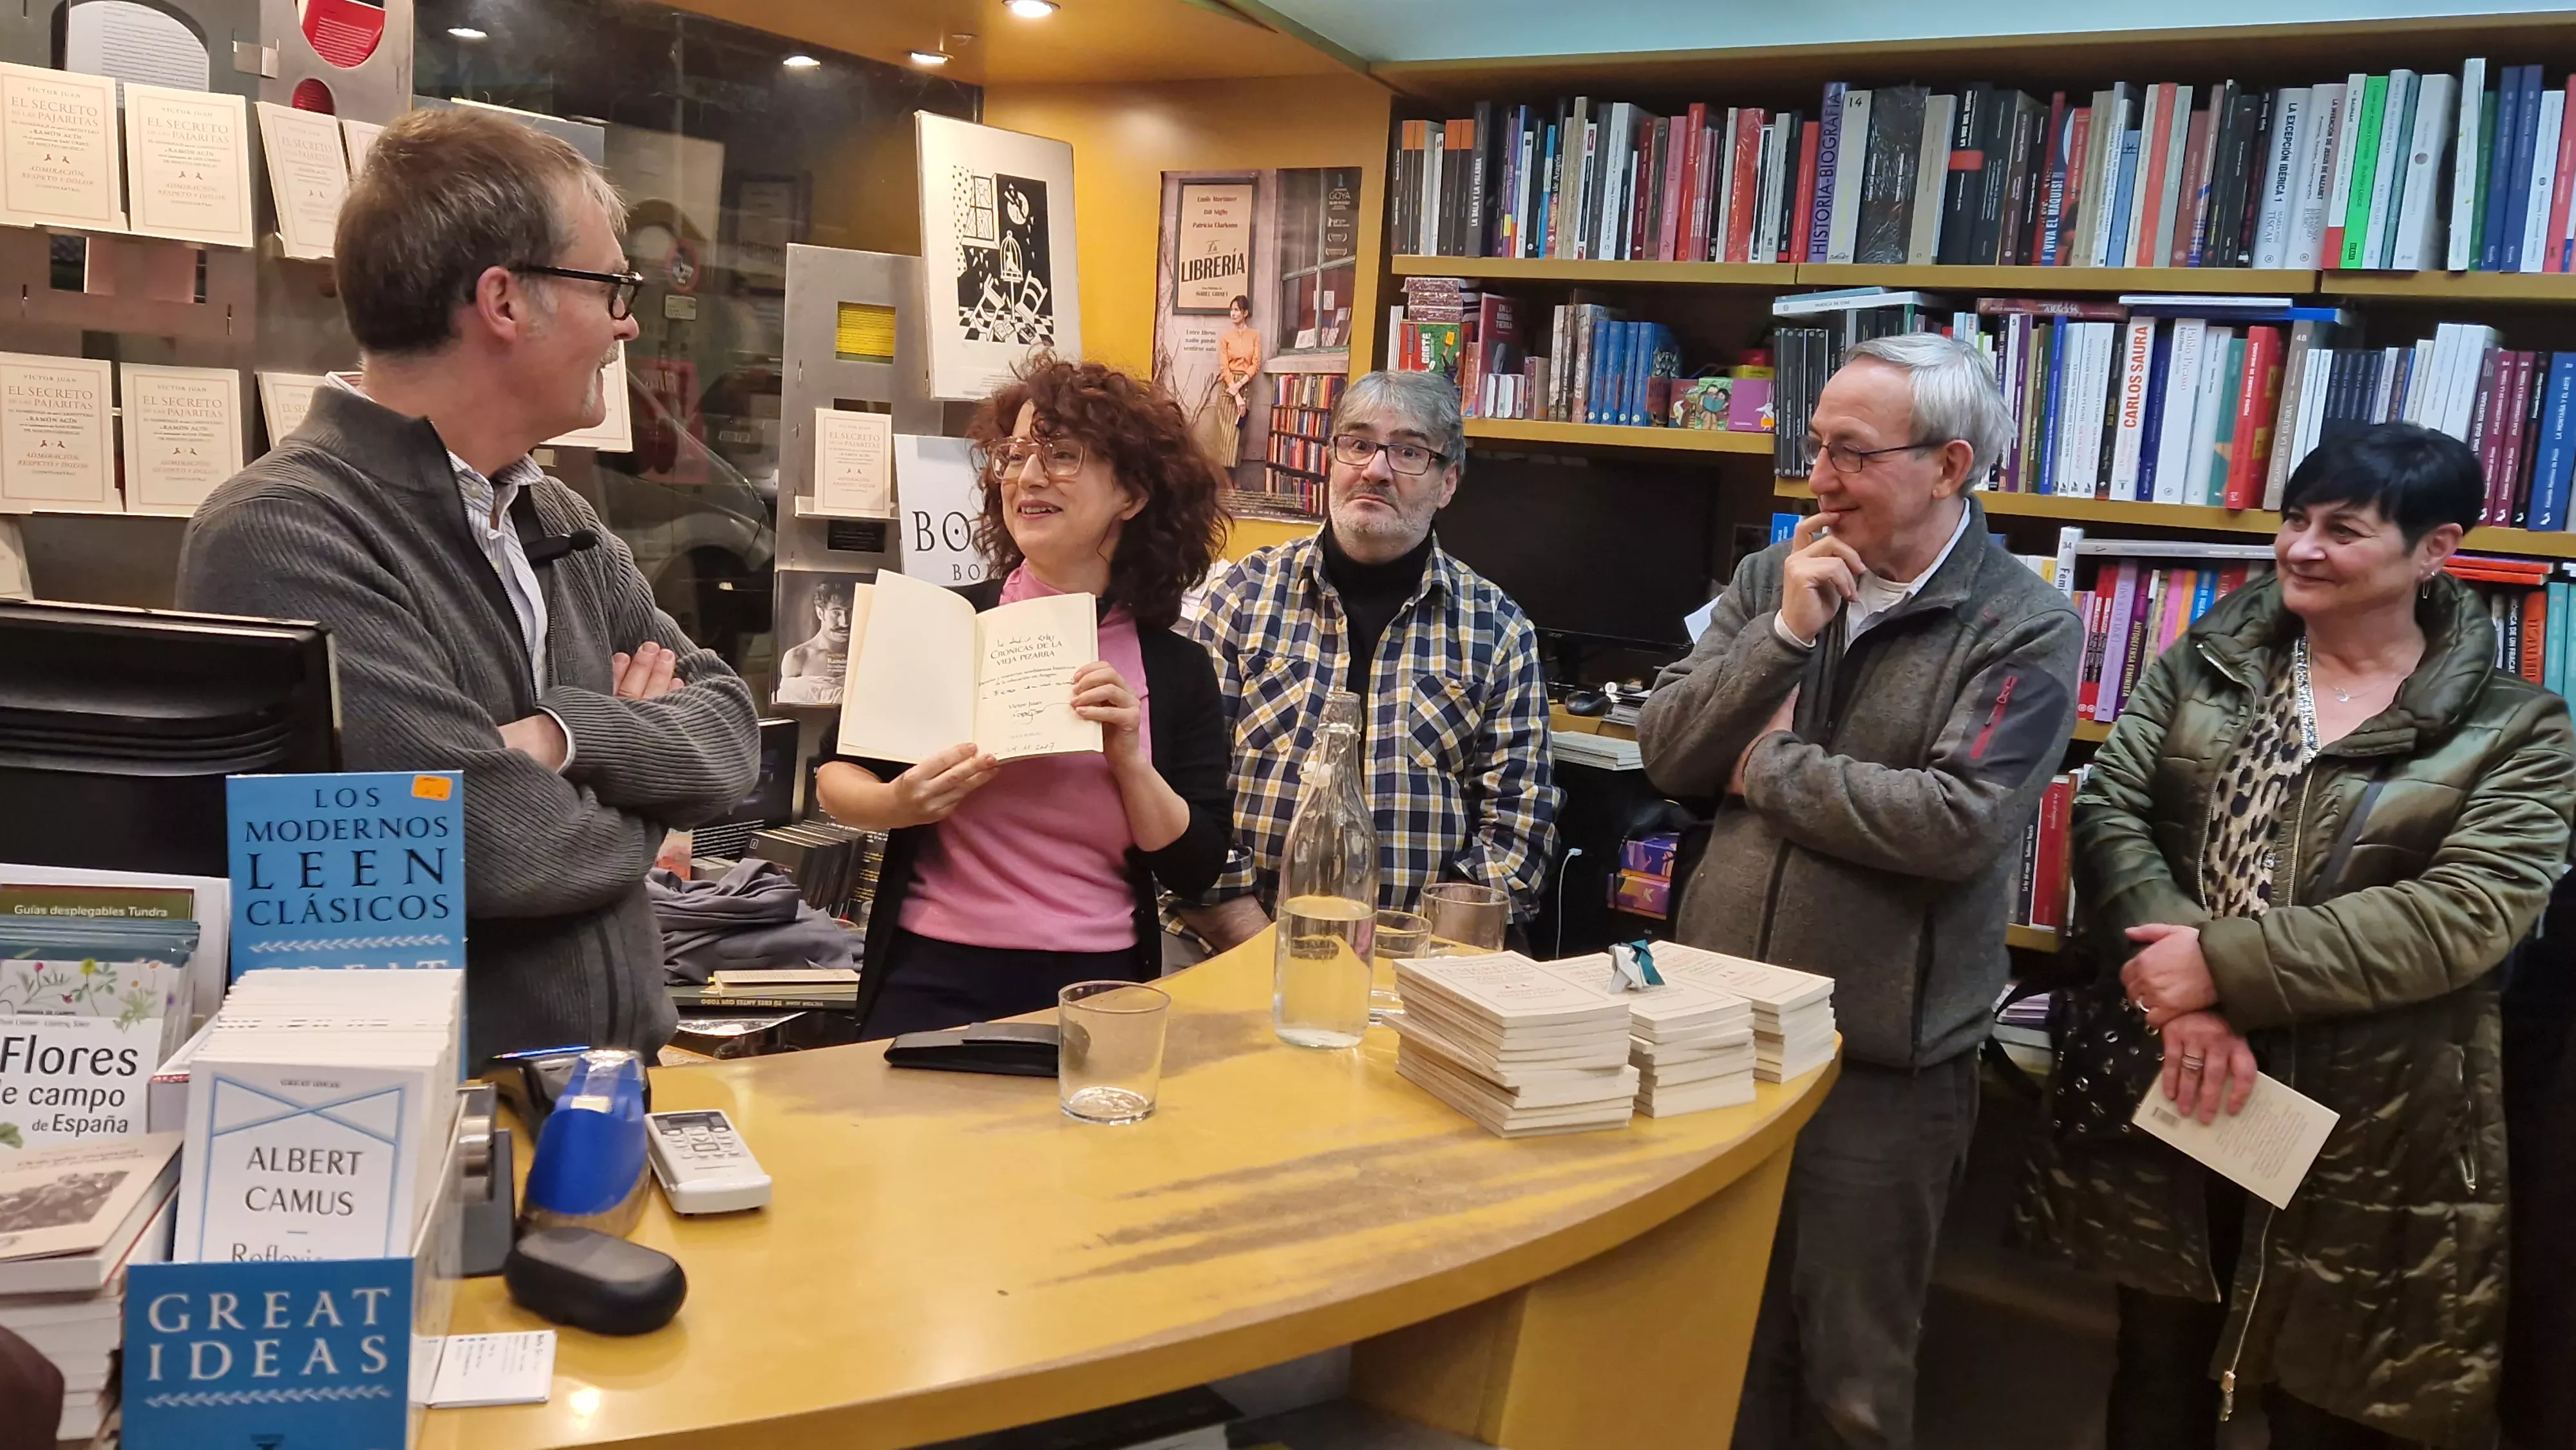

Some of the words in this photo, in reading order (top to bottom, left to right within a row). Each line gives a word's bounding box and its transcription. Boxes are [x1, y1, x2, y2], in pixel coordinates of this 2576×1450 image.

[11, 96, 28, 108] EL
[32, 99, 98, 117] SECRETO
[1849, 97, 1863, 108] 14
[2287, 102, 2298, 115] LA
[38, 111, 99, 127] PAJARITAS
[147, 117, 162, 127] EL
[166, 119, 229, 134] SECRETO
[172, 131, 229, 144] PAJARITAS
[294, 138, 332, 153] SECRETO
[2280, 115, 2298, 162] EXCEPCIÓN
[1553, 153, 1562, 180] Aragón
[2275, 163, 2289, 196] IBÉRICA
[1329, 192, 1351, 200] GOYA
[1181, 248, 1245, 283] LIBRERÍA
[2130, 326, 2150, 373] SAURA
[2184, 328, 2197, 356] Pablo
[2181, 357, 2193, 391] Picasso
[8, 386, 24, 396] EL
[28, 387, 93, 400] SECRETO
[34, 399, 93, 410] PAJARITAS
[143, 396, 158, 405] EL
[162, 397, 223, 408] SECRETO
[2124, 375, 2143, 428] CARLOS
[167, 408, 223, 418] PAJARITAS
[841, 432, 880, 442] SECRETO
[2280, 435, 2287, 446] LA
[2278, 447, 2286, 457] DE
[912, 511, 971, 552] BO
[1037, 641, 1049, 650] DE
[2127, 620, 2142, 663] AUTODEFENSA
[996, 657, 1018, 666] VIEJA
[1019, 650, 1055, 661] PIZARRA
[2121, 663, 2134, 697] FEMINISTA
[315, 787, 380, 808] LOS
[245, 816, 449, 842] MODERNOS
[247, 847, 448, 891] LEEN
[14, 904, 46, 917] Guías
[50, 903, 125, 918] desplegables
[128, 905, 167, 918] Tundra
[246, 890, 450, 927] CLÁSICOS
[0, 1035, 138, 1077] Flores
[0, 1079, 18, 1105] e
[28, 1087, 125, 1114] campo
[32, 1119, 49, 1132] de
[52, 1113, 128, 1138] España
[246, 1146, 363, 1178] ALBERT
[245, 1187, 354, 1217] CAMUS
[148, 1288, 391, 1333] GREAT
[147, 1334, 388, 1381] IDEAS
